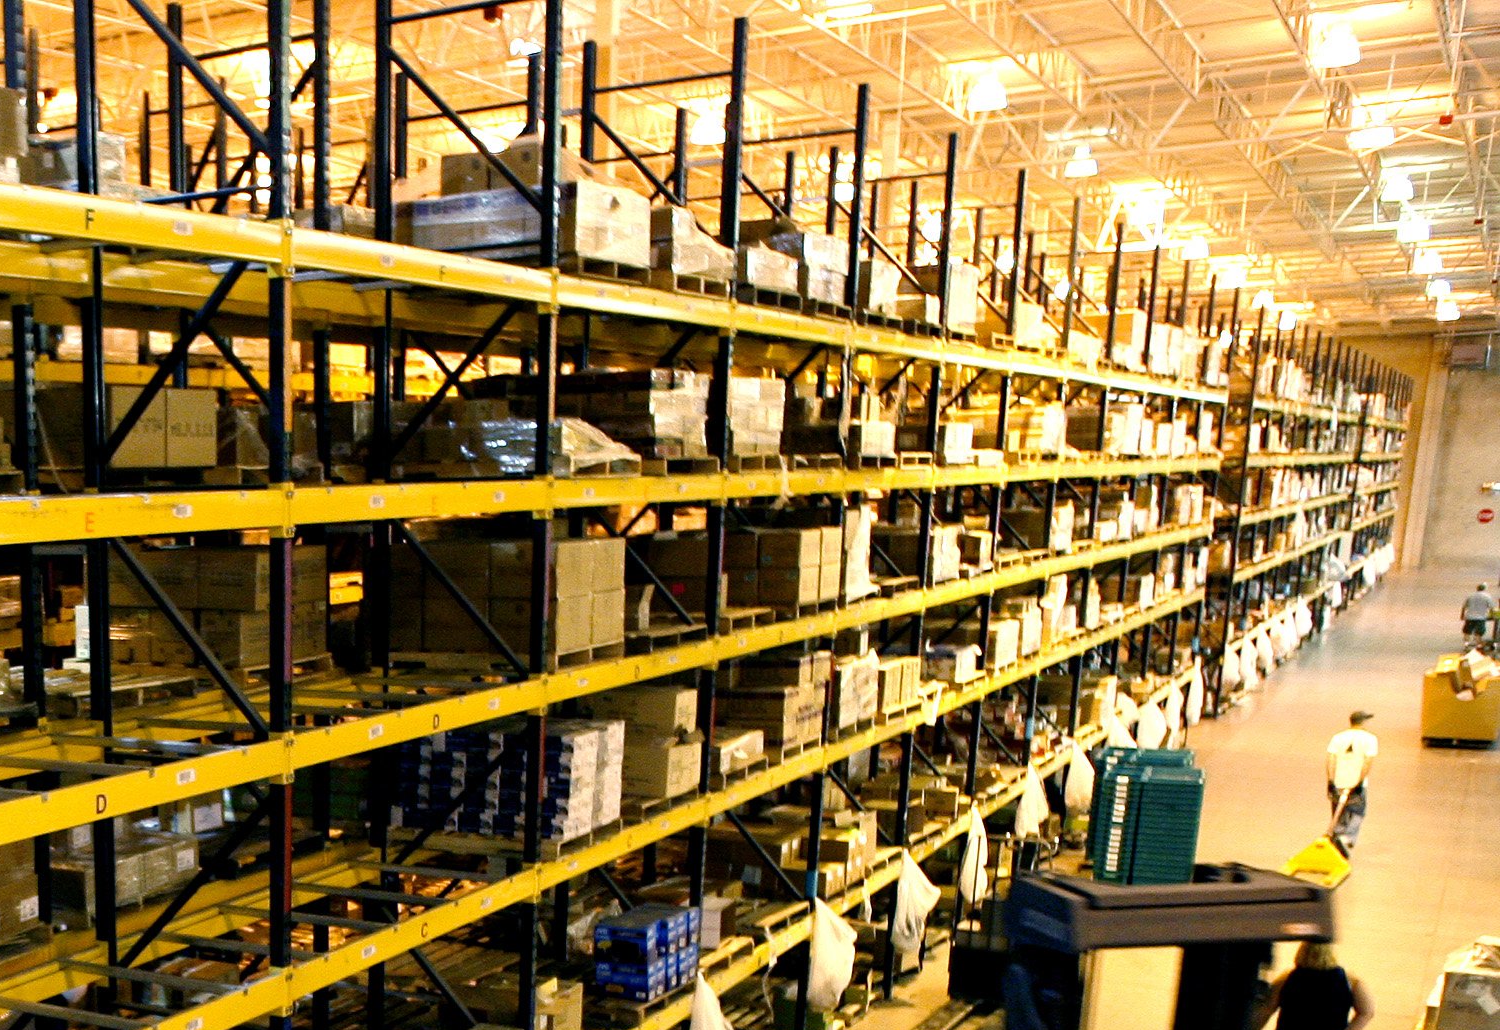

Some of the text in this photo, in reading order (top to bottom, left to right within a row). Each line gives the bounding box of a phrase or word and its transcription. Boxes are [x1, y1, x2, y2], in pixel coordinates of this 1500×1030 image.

[85, 207, 96, 231] F
[84, 511, 96, 533] E
[96, 794, 107, 814] D
